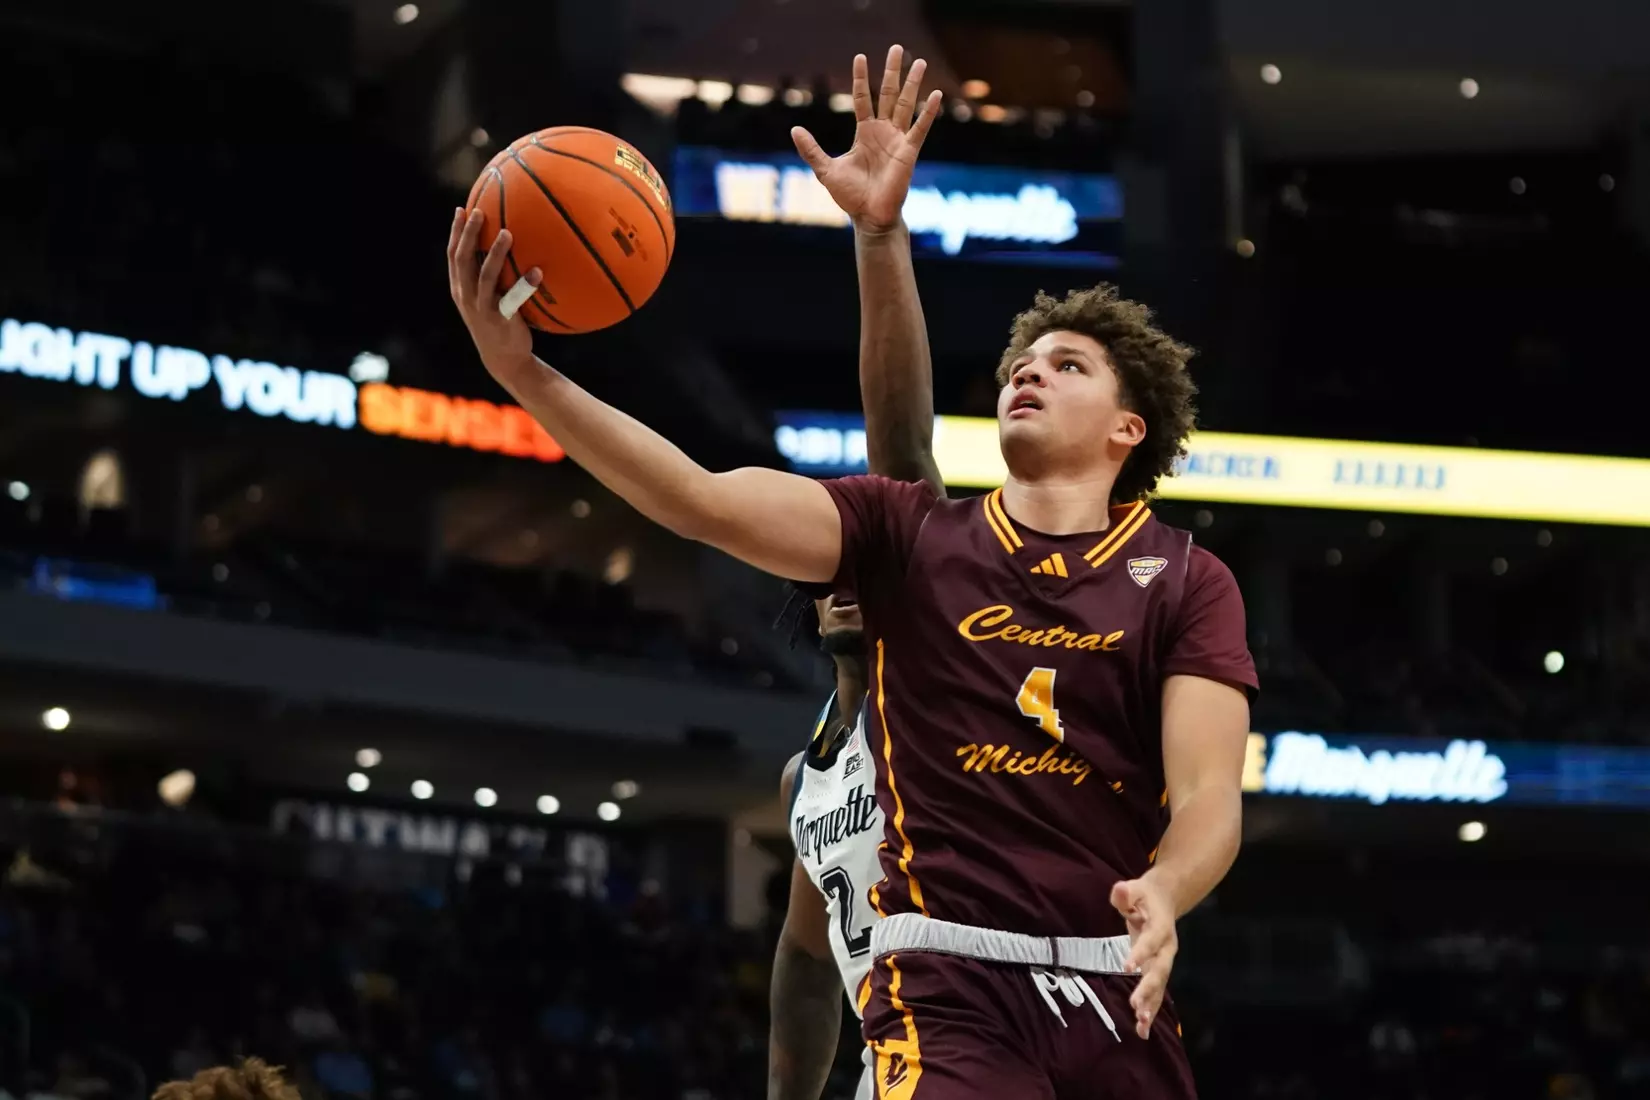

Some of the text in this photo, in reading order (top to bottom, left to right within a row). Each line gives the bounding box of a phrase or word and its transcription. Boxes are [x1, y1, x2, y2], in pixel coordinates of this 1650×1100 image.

[0, 317, 131, 389] IGHT
[131, 341, 210, 400] UP
[212, 354, 357, 429] YOUR
[958, 604, 1125, 651] Central
[1015, 666, 1064, 744] 4
[956, 743, 1125, 794] Michig
